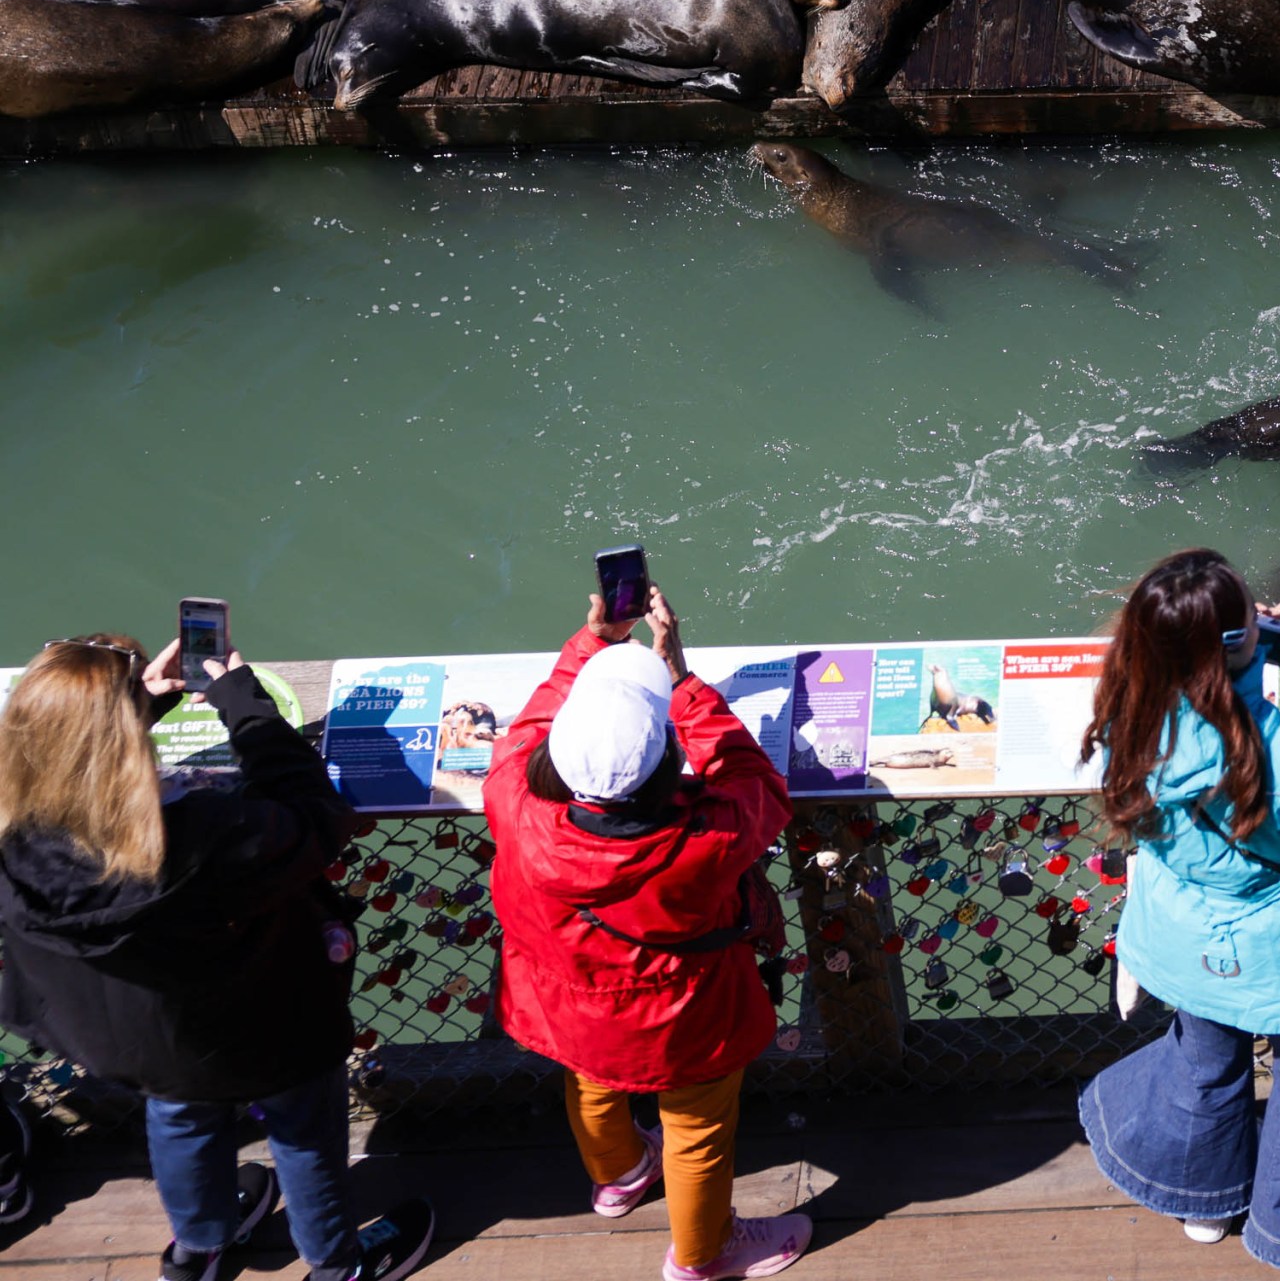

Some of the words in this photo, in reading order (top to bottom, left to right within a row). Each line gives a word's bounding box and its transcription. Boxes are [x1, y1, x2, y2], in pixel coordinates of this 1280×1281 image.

[1006, 655, 1039, 664] When
[1041, 656, 1060, 664] are
[1061, 656, 1081, 664] sea
[1006, 665, 1017, 673] at
[1019, 664, 1049, 673] PIER
[1051, 663, 1074, 672] 39?
[377, 676, 402, 685] are
[405, 672, 430, 685] the
[739, 671, 788, 680] Commerce
[338, 687, 370, 699] SEA
[376, 686, 425, 698] LIONS
[876, 690, 905, 699] apart?
[337, 702, 350, 711] at
[355, 699, 394, 711] PIER
[399, 698, 427, 710] 39?
[157, 745, 174, 753] The
